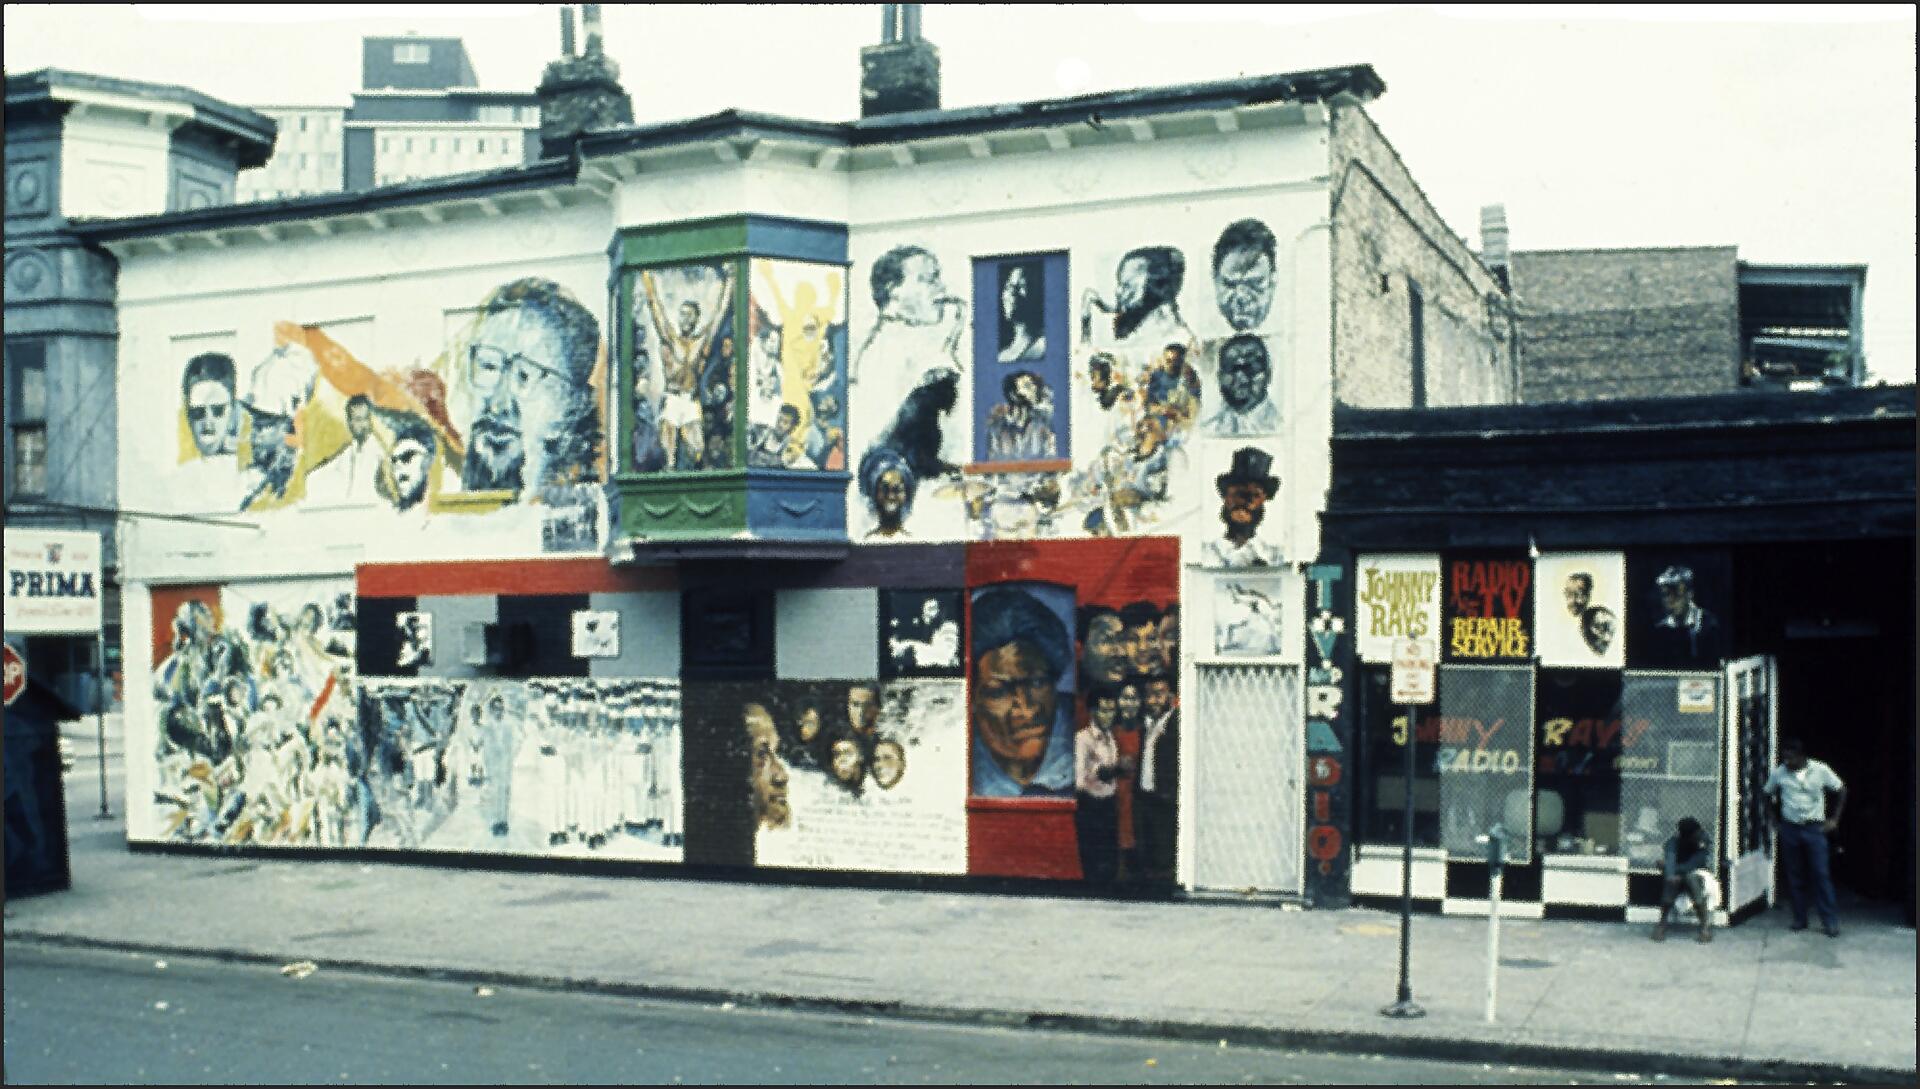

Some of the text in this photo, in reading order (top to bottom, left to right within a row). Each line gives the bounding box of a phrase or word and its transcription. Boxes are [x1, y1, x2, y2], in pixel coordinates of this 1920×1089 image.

[9, 570, 96, 598] PRIMA
[1361, 568, 1437, 603] JOHNNY
[1452, 560, 1530, 595] RADIO
[1480, 589, 1527, 619] TV
[1452, 636, 1529, 657] SERVICE
[1434, 748, 1520, 774] RADIO
